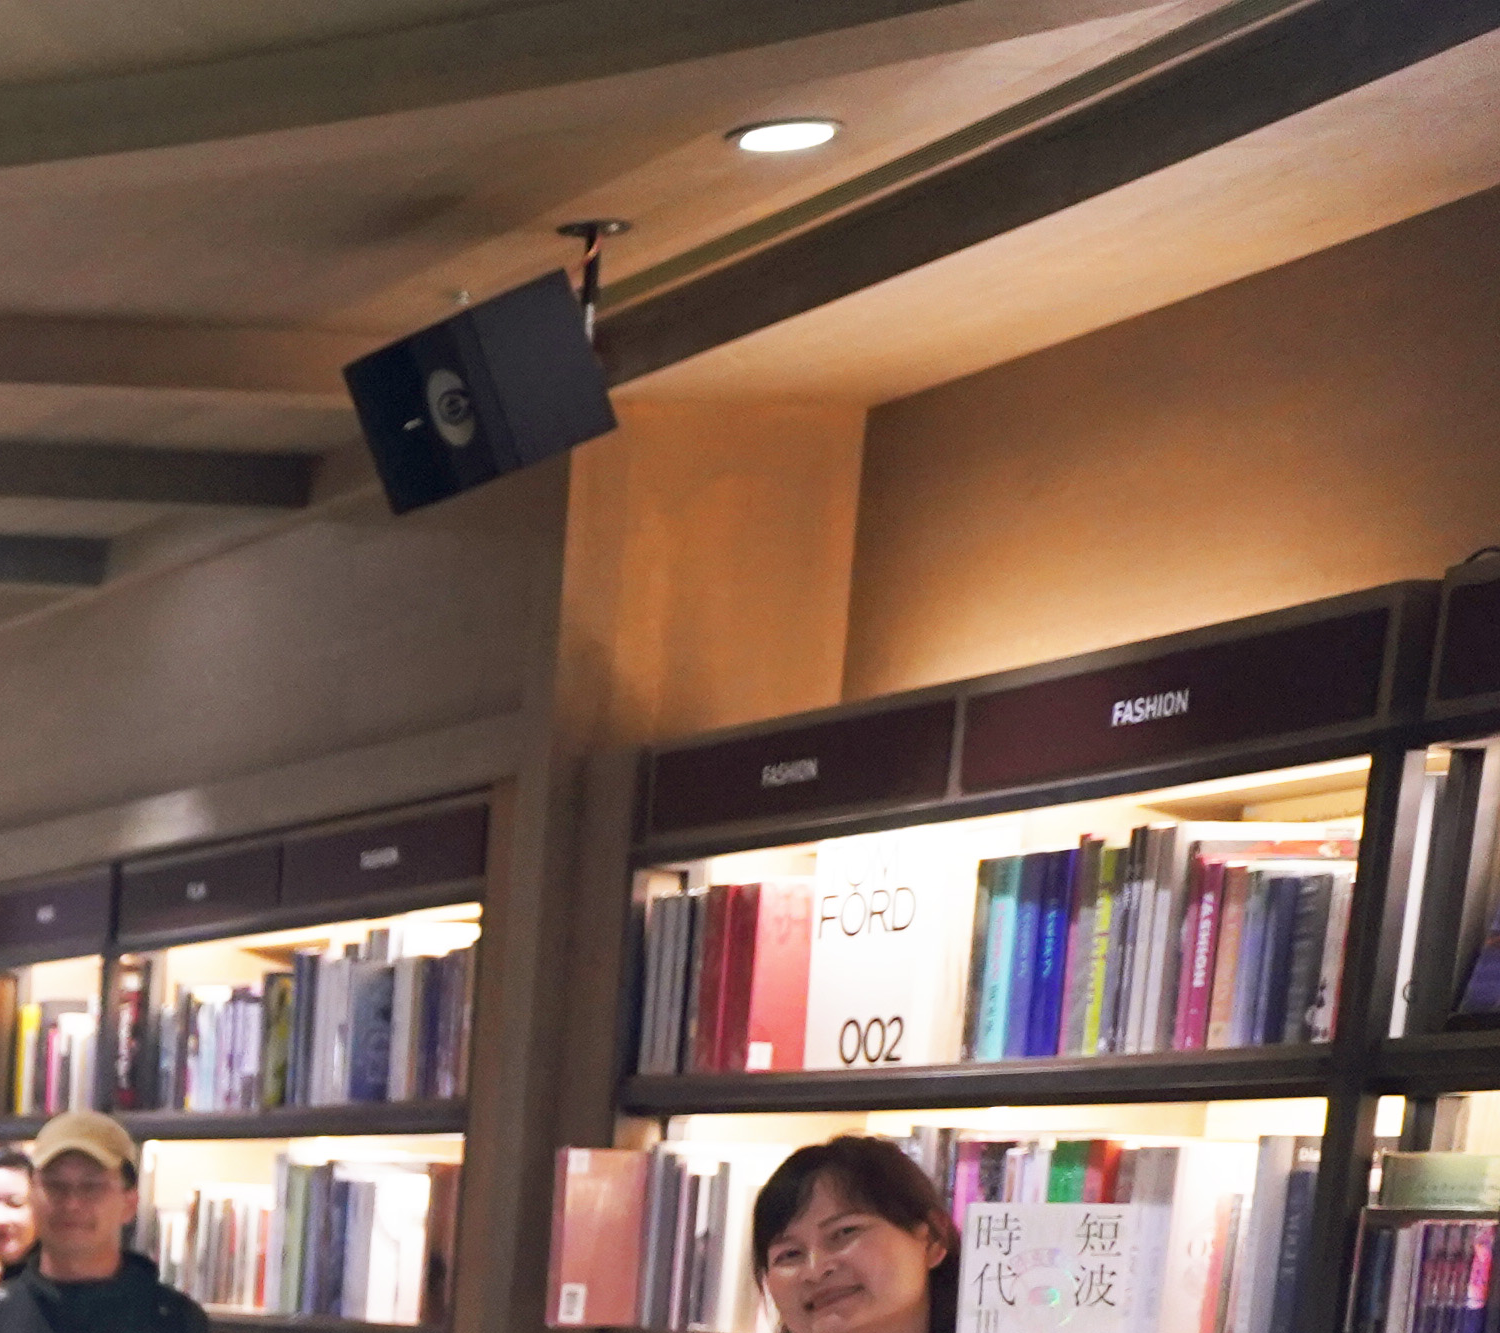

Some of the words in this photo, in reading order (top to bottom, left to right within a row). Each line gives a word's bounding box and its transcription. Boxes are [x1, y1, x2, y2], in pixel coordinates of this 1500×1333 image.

[1111, 690, 1189, 727] FASHION
[761, 757, 819, 788] FASHION
[818, 886, 917, 940] FORD
[839, 1016, 905, 1065] 002
[972, 1213, 1022, 1306] 時代
[1075, 1213, 1123, 1307] 短波
